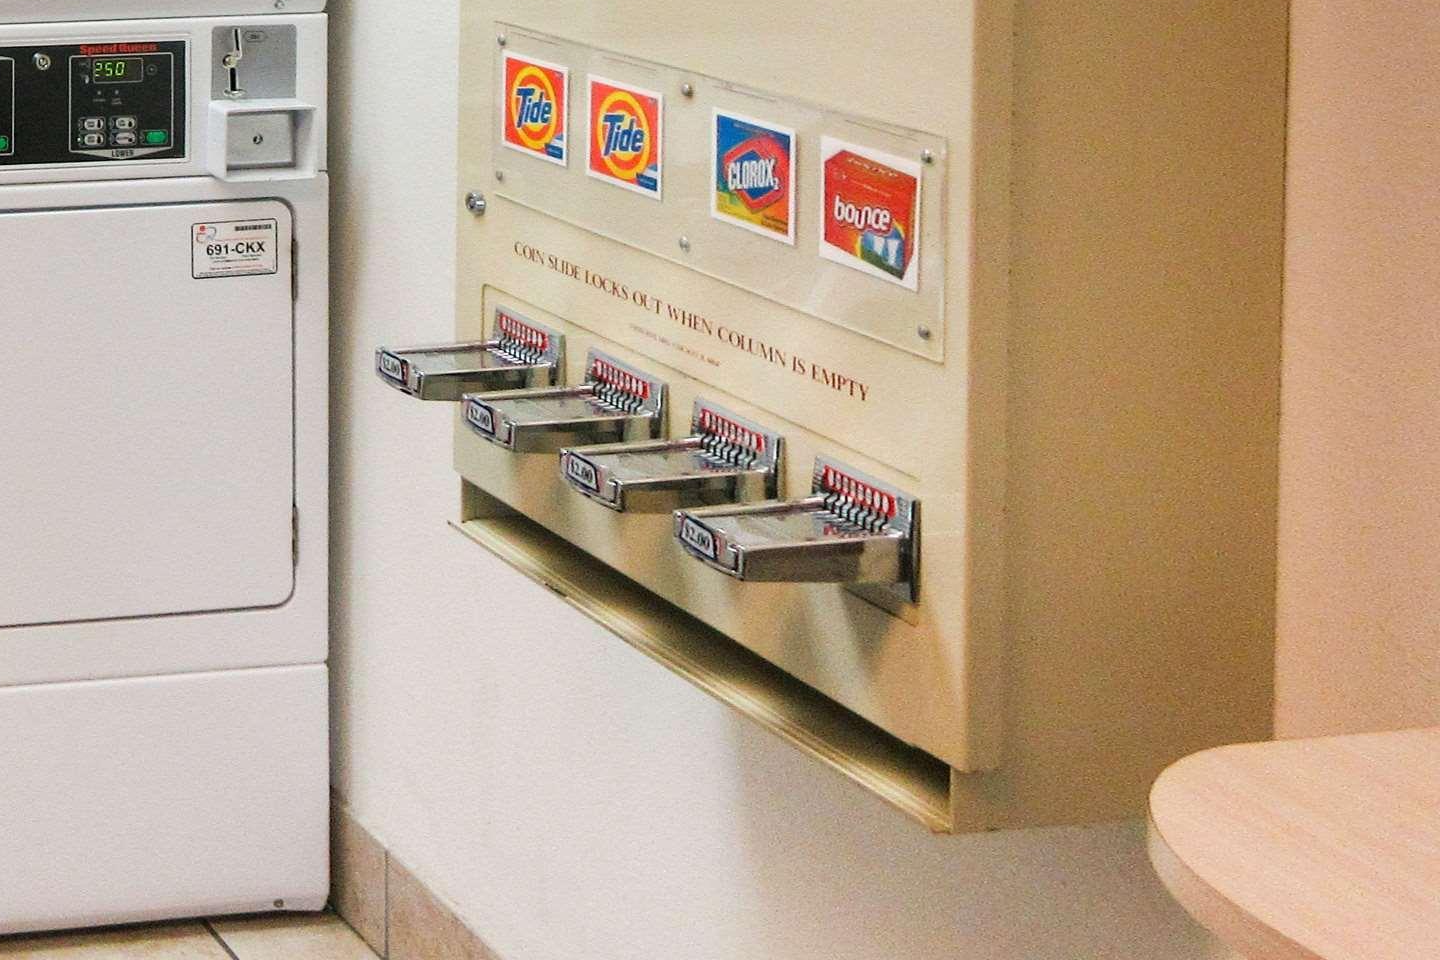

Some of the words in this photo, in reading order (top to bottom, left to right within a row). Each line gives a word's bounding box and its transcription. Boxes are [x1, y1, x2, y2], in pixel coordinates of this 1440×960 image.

[80, 44, 116, 55] Speed
[119, 43, 158, 53] Queen
[516, 87, 552, 128] Tide
[603, 114, 645, 156] Tide
[834, 194, 890, 231] bounce
[207, 241, 265, 256] 691-CKX
[514, 241, 545, 264] COIN
[548, 255, 581, 280] SLIDE
[585, 270, 629, 300] LOCKS
[633, 290, 662, 314] OUT
[666, 303, 713, 335] WHEN
[718, 326, 787, 367] COLUMN
[792, 356, 806, 375] IS
[812, 363, 870, 401] EMPTY
[570, 459, 593, 484] $2.00
[684, 524, 711, 549] $2.00
